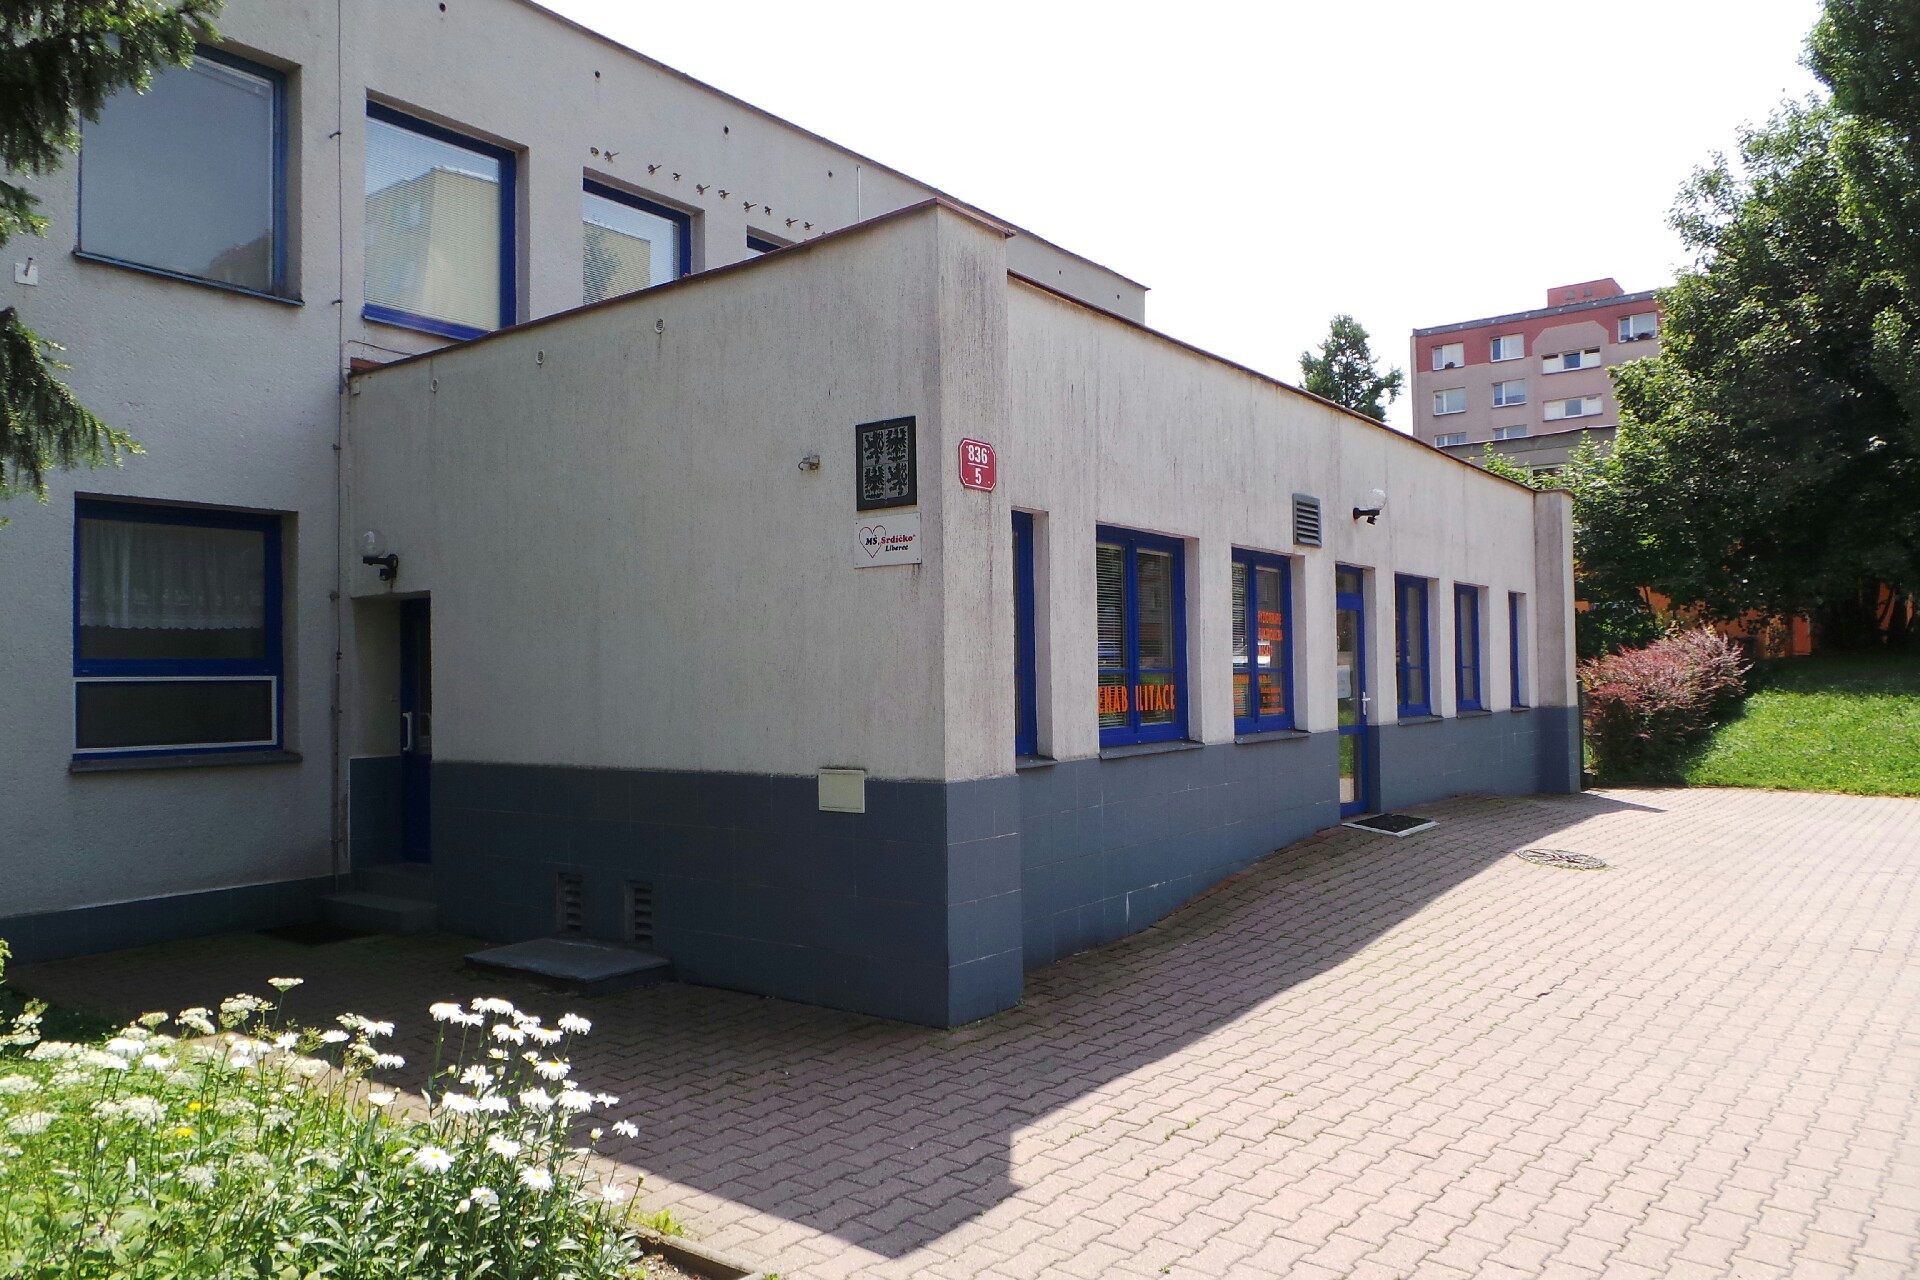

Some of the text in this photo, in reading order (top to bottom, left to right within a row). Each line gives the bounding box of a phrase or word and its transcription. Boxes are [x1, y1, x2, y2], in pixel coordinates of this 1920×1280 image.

[968, 445, 988, 464] 836
[975, 467, 982, 484] 5
[1098, 685, 1175, 713] EHABILITACE
